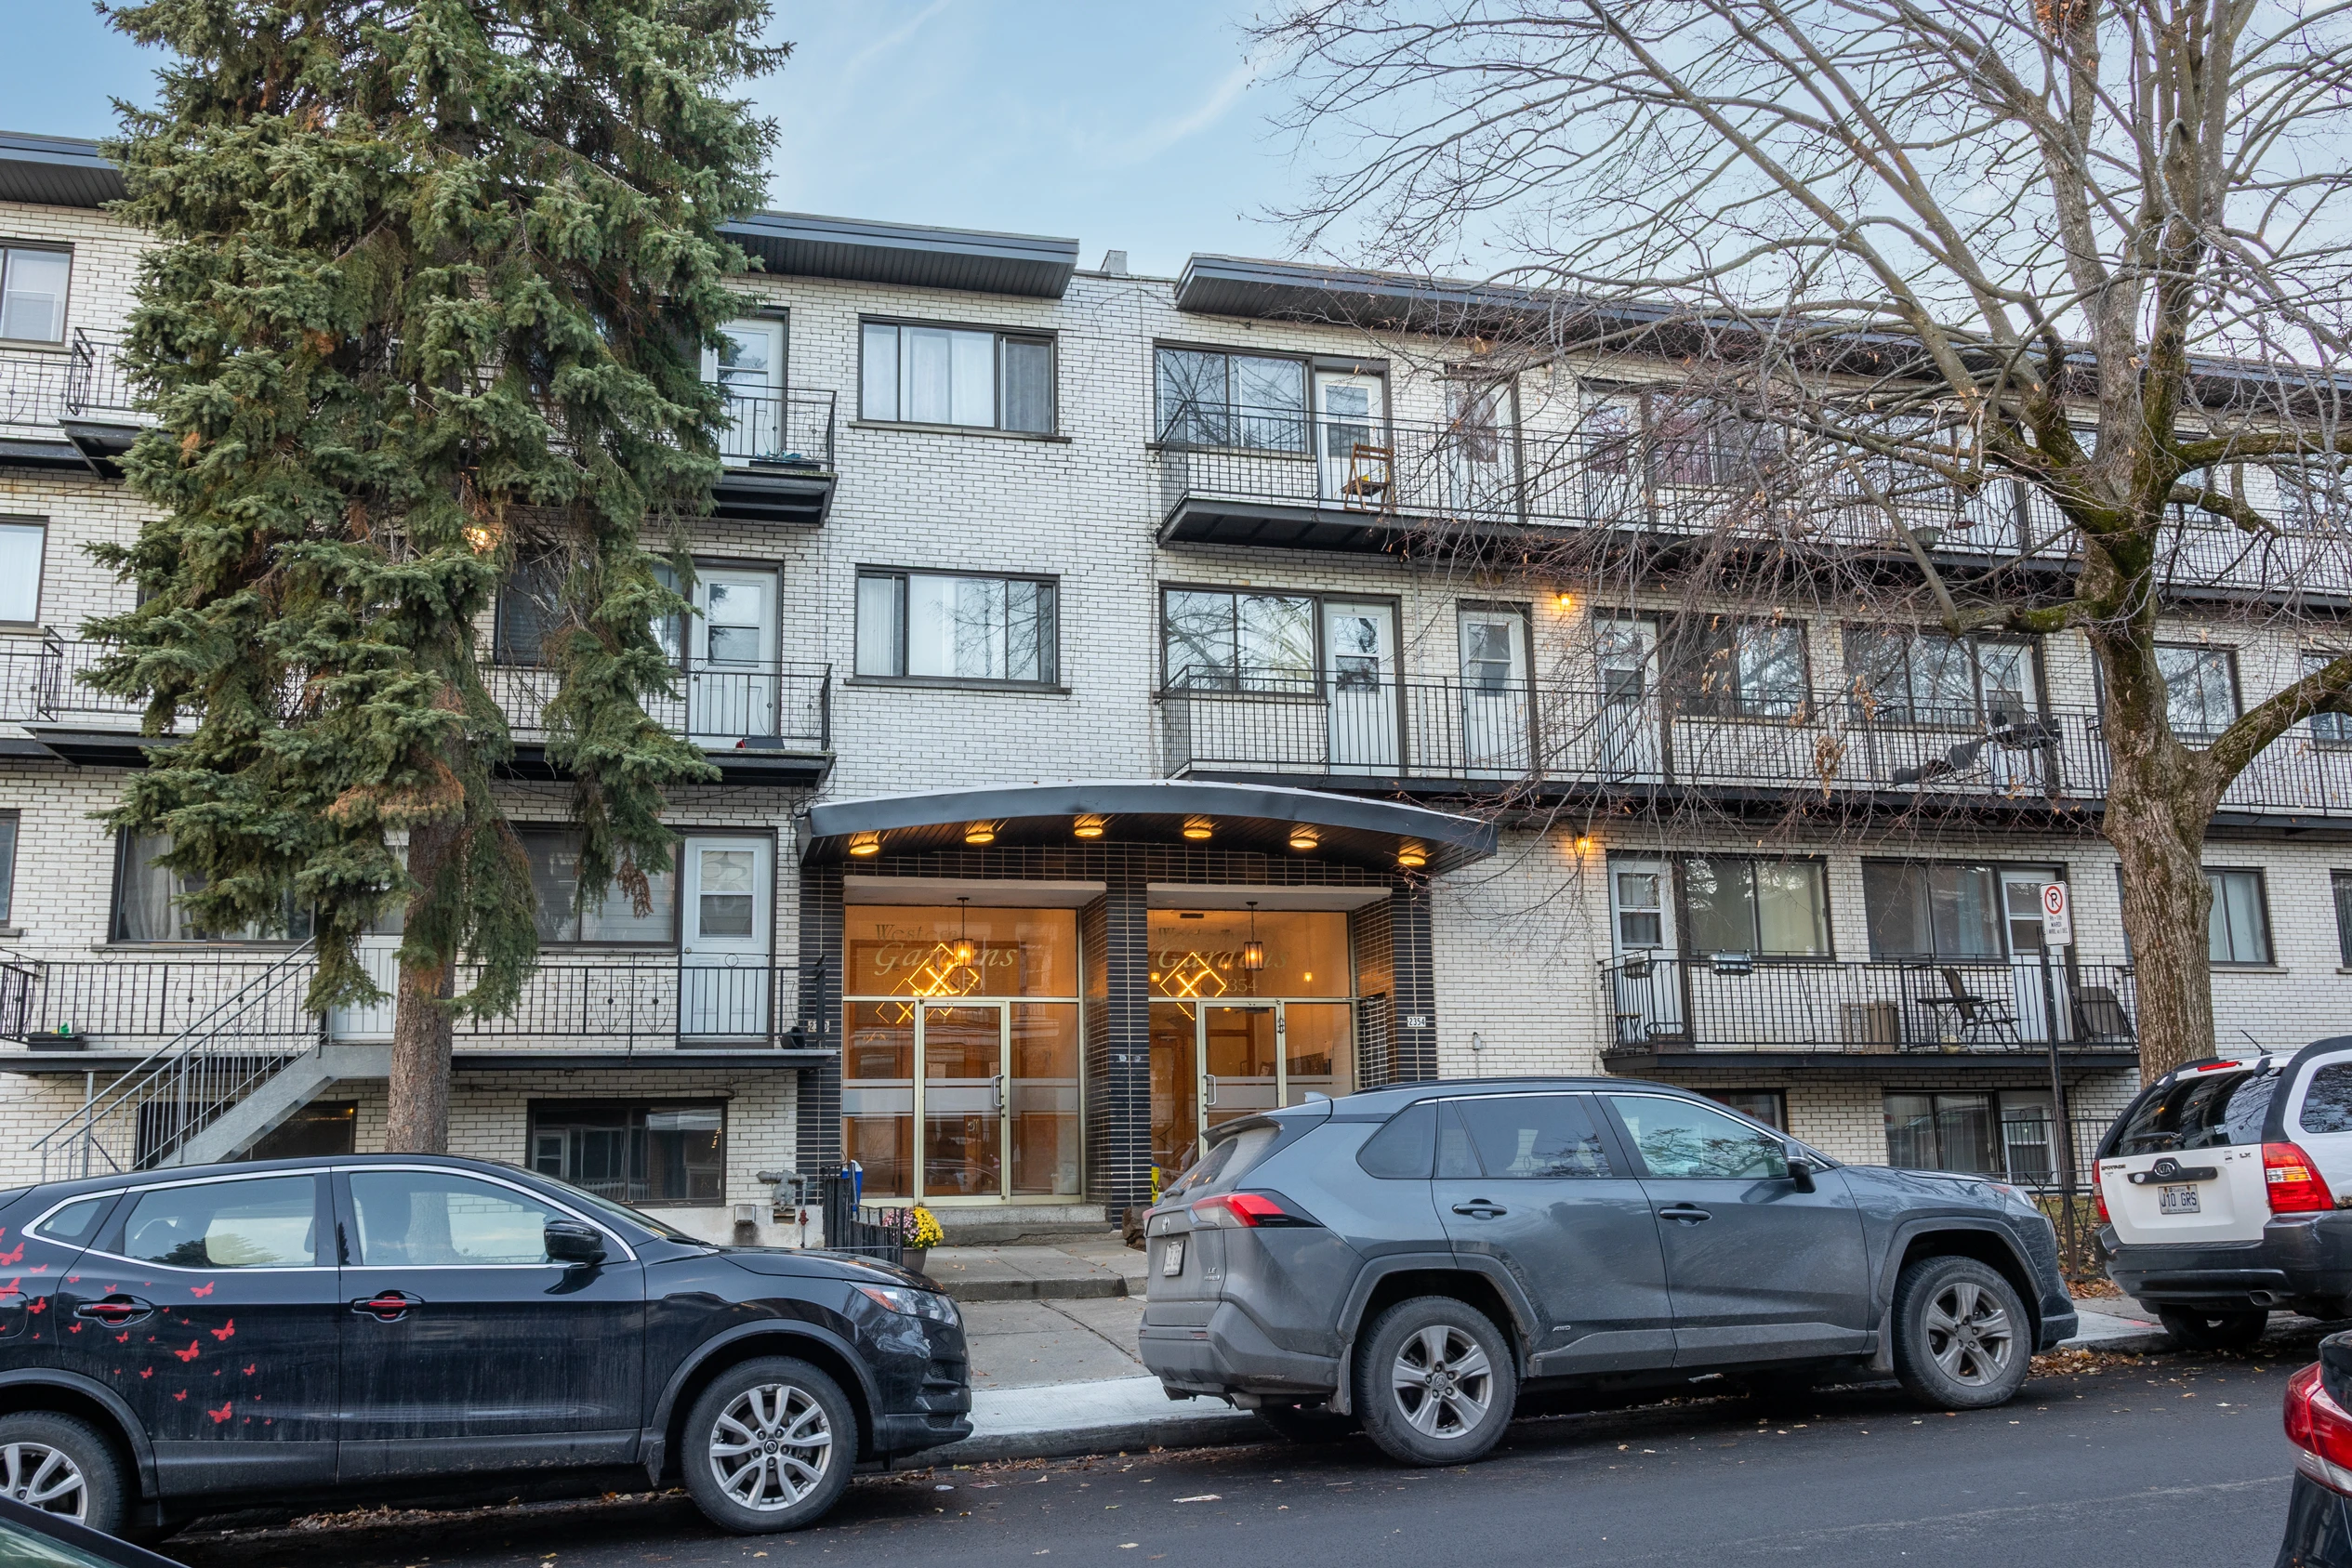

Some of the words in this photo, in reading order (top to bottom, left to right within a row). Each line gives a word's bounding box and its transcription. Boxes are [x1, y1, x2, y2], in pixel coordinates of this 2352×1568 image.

[950, 977, 983, 991] 350
[1222, 979, 1258, 993] 2354
[2180, 1192, 2197, 1206] GRS
